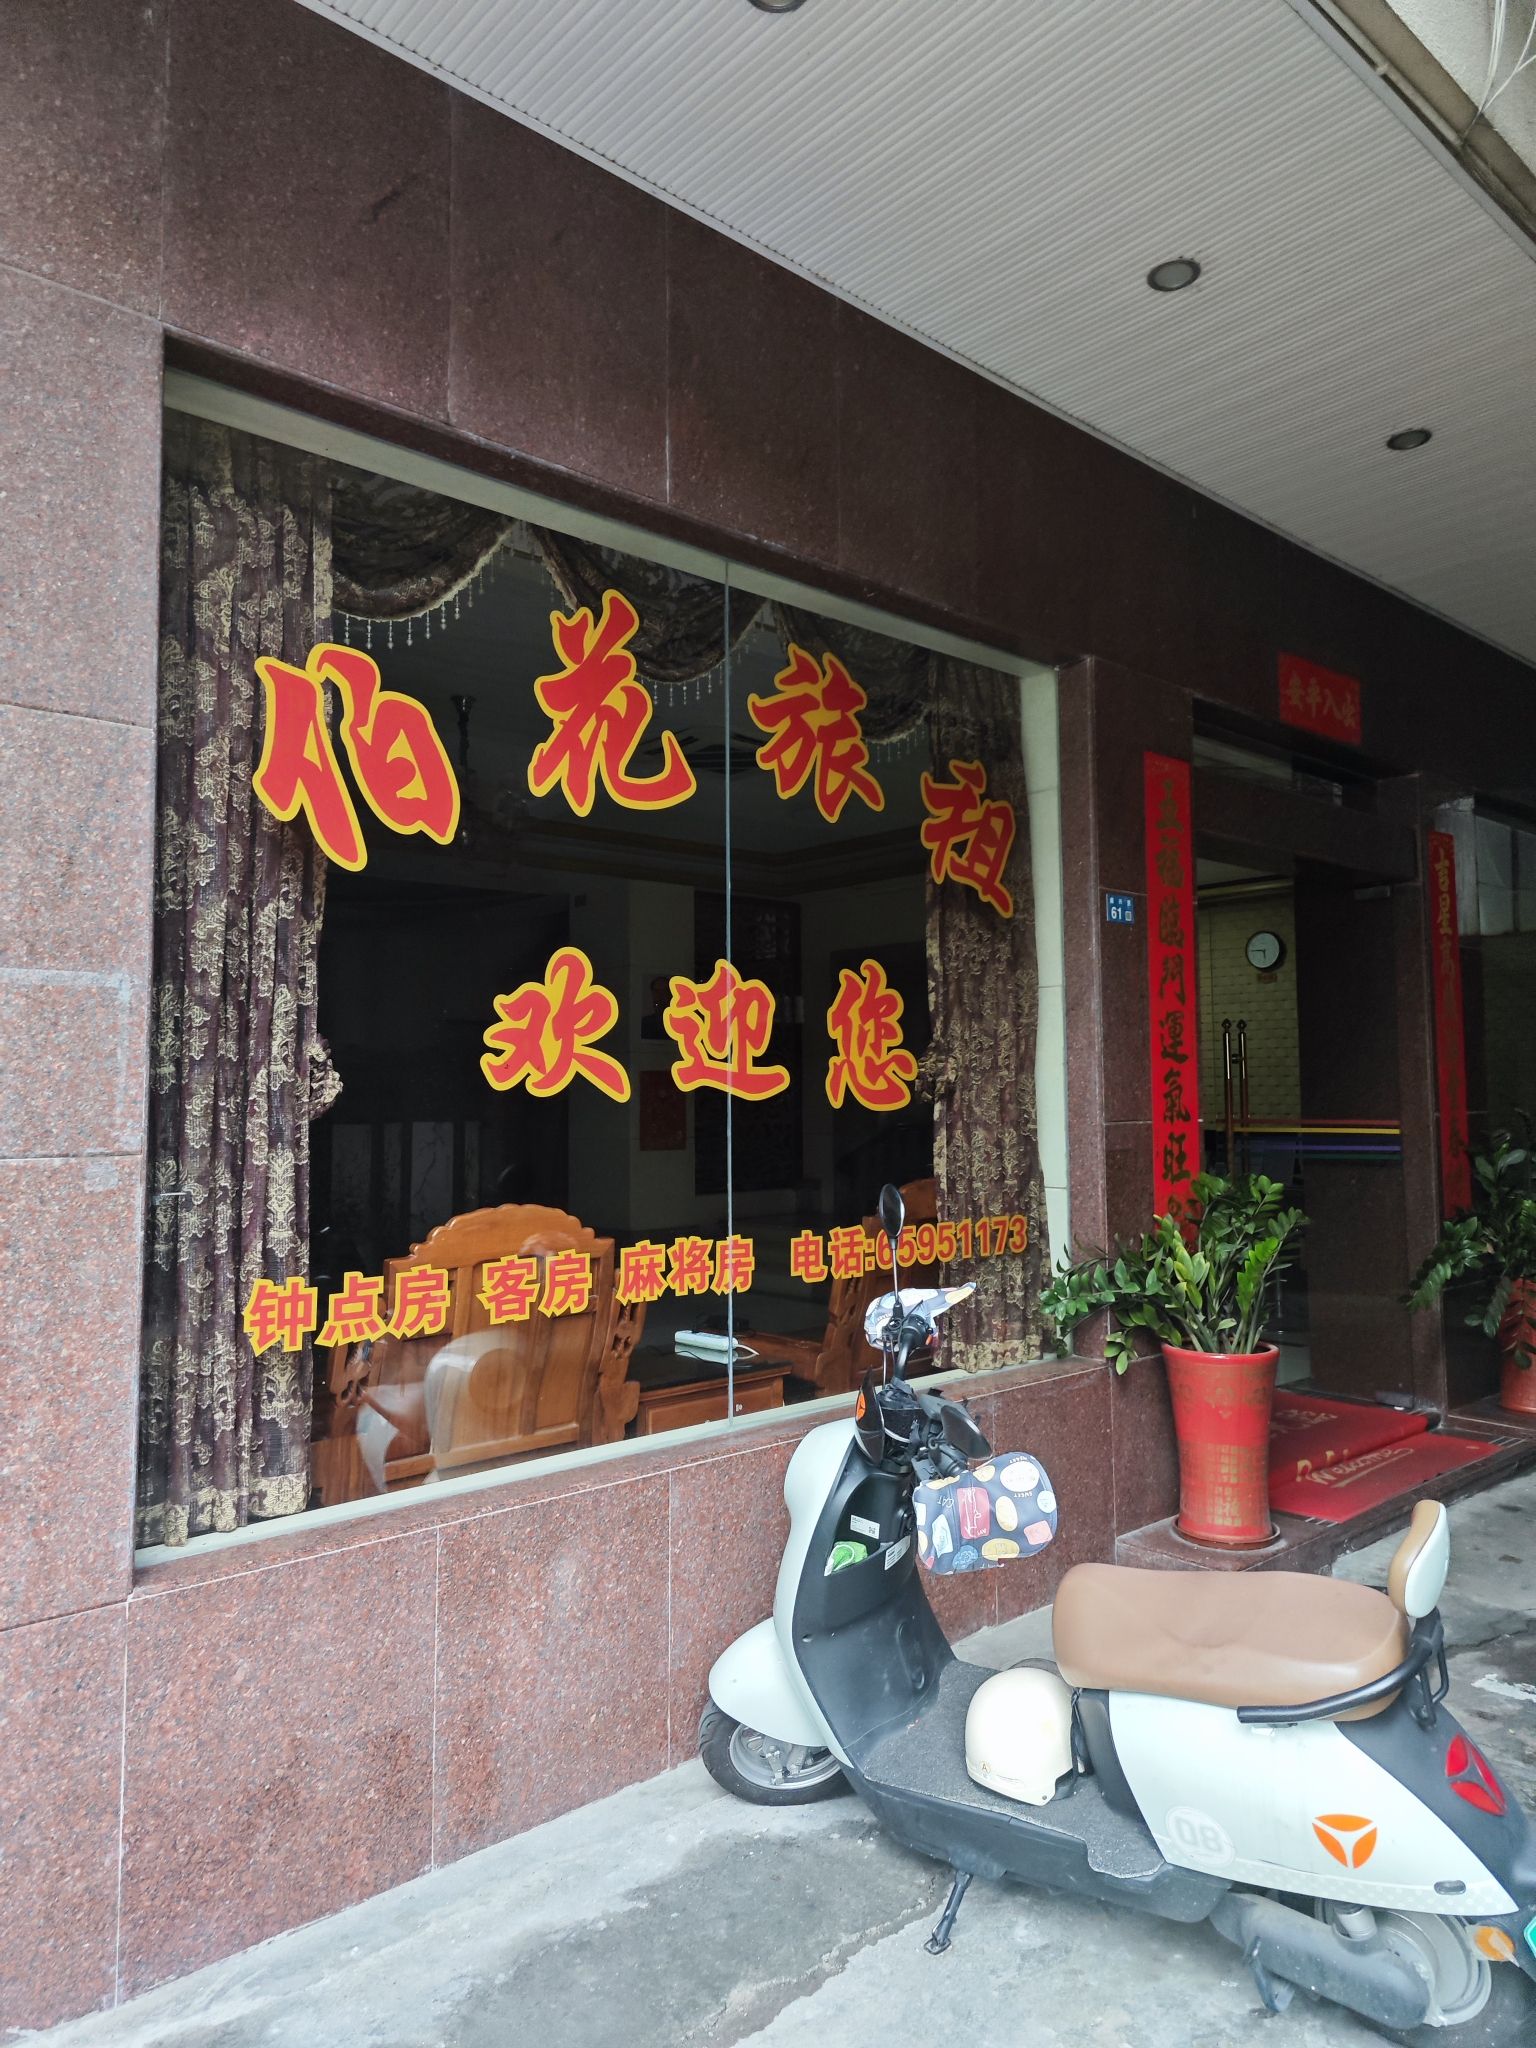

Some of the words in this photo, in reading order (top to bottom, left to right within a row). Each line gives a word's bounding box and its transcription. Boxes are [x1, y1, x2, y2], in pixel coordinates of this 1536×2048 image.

[1111, 906, 1122, 920] 61
[480, 947, 917, 1111] 欢迎您
[242, 1264, 451, 1356] 钟点房
[477, 1249, 592, 1324] 客房
[616, 1234, 755, 1304] 麻将房
[1174, 1816, 1223, 1852] 08
